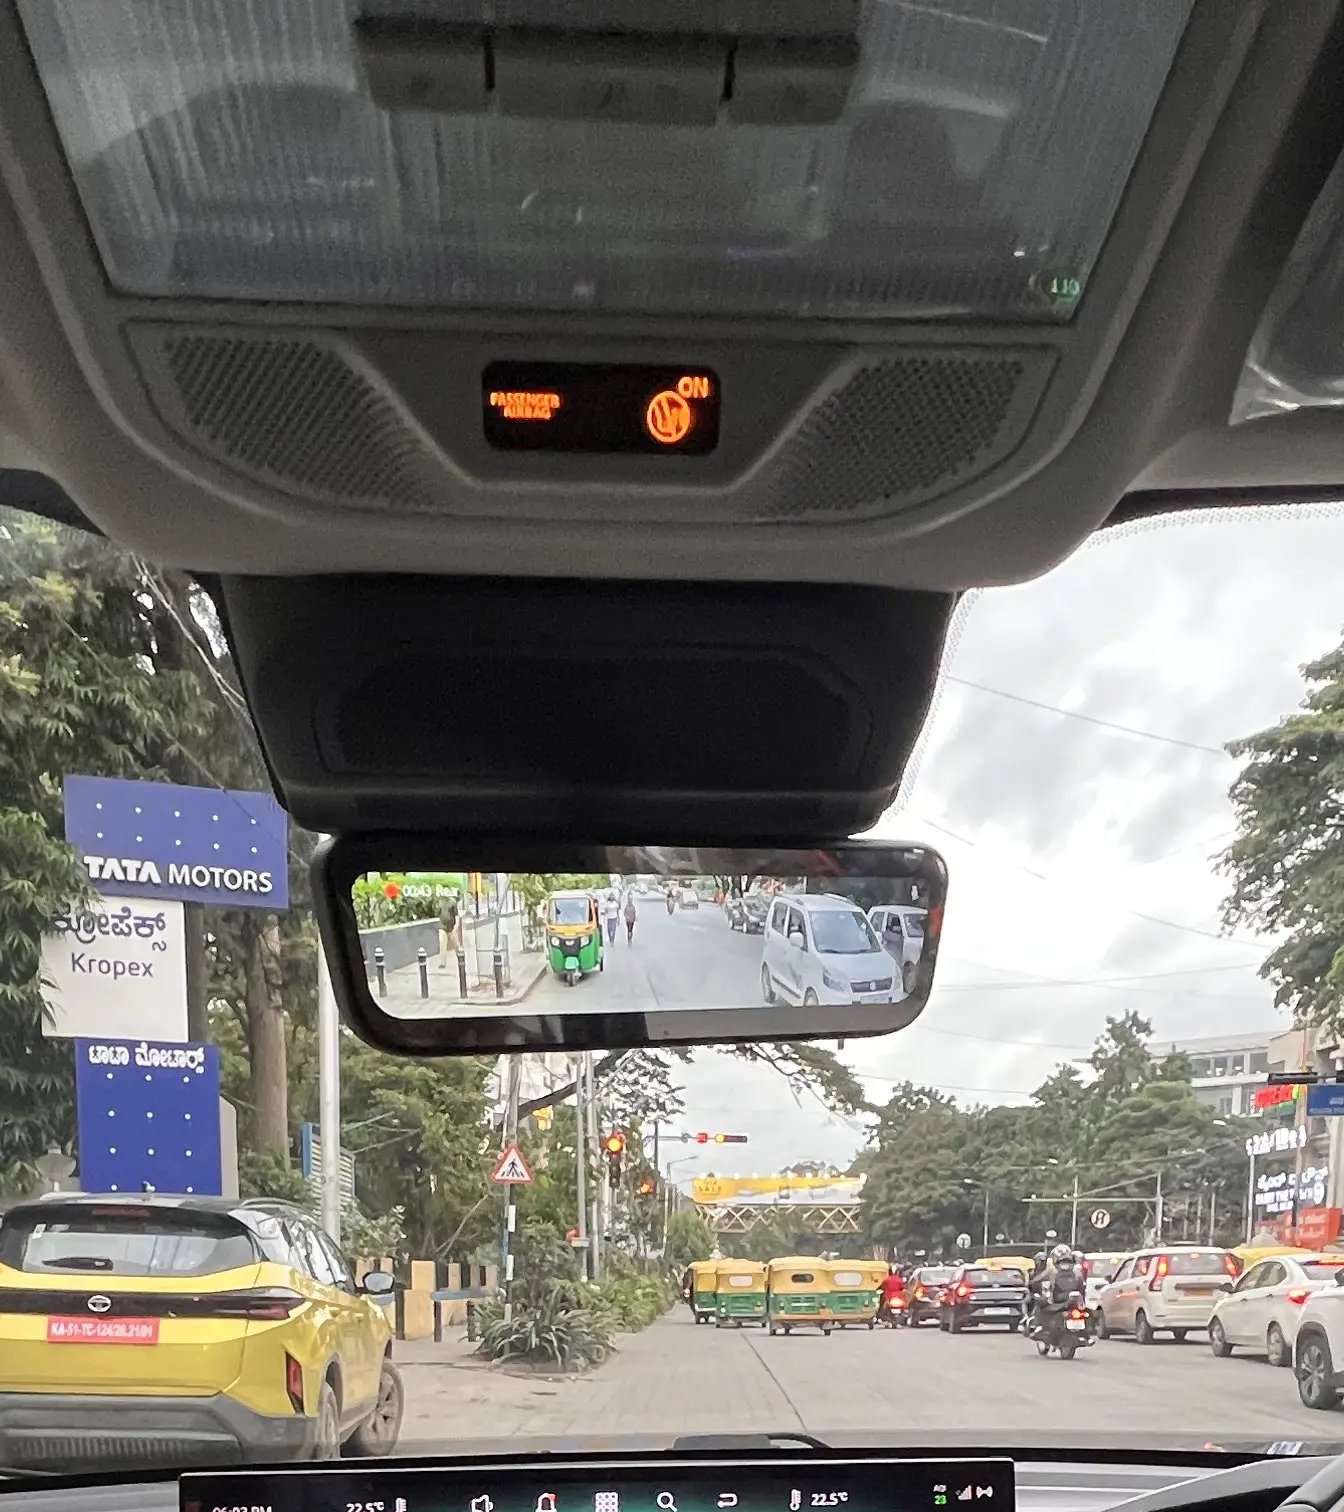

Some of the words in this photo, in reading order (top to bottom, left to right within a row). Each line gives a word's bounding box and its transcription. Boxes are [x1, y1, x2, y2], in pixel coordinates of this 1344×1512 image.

[678, 377, 709, 398] ON
[490, 392, 560, 407] PASSENGER
[83, 856, 162, 885] TATA
[168, 863, 274, 894] MOTORS
[71, 953, 154, 981] Kropex
[934, 1495, 947, 1505] 23
